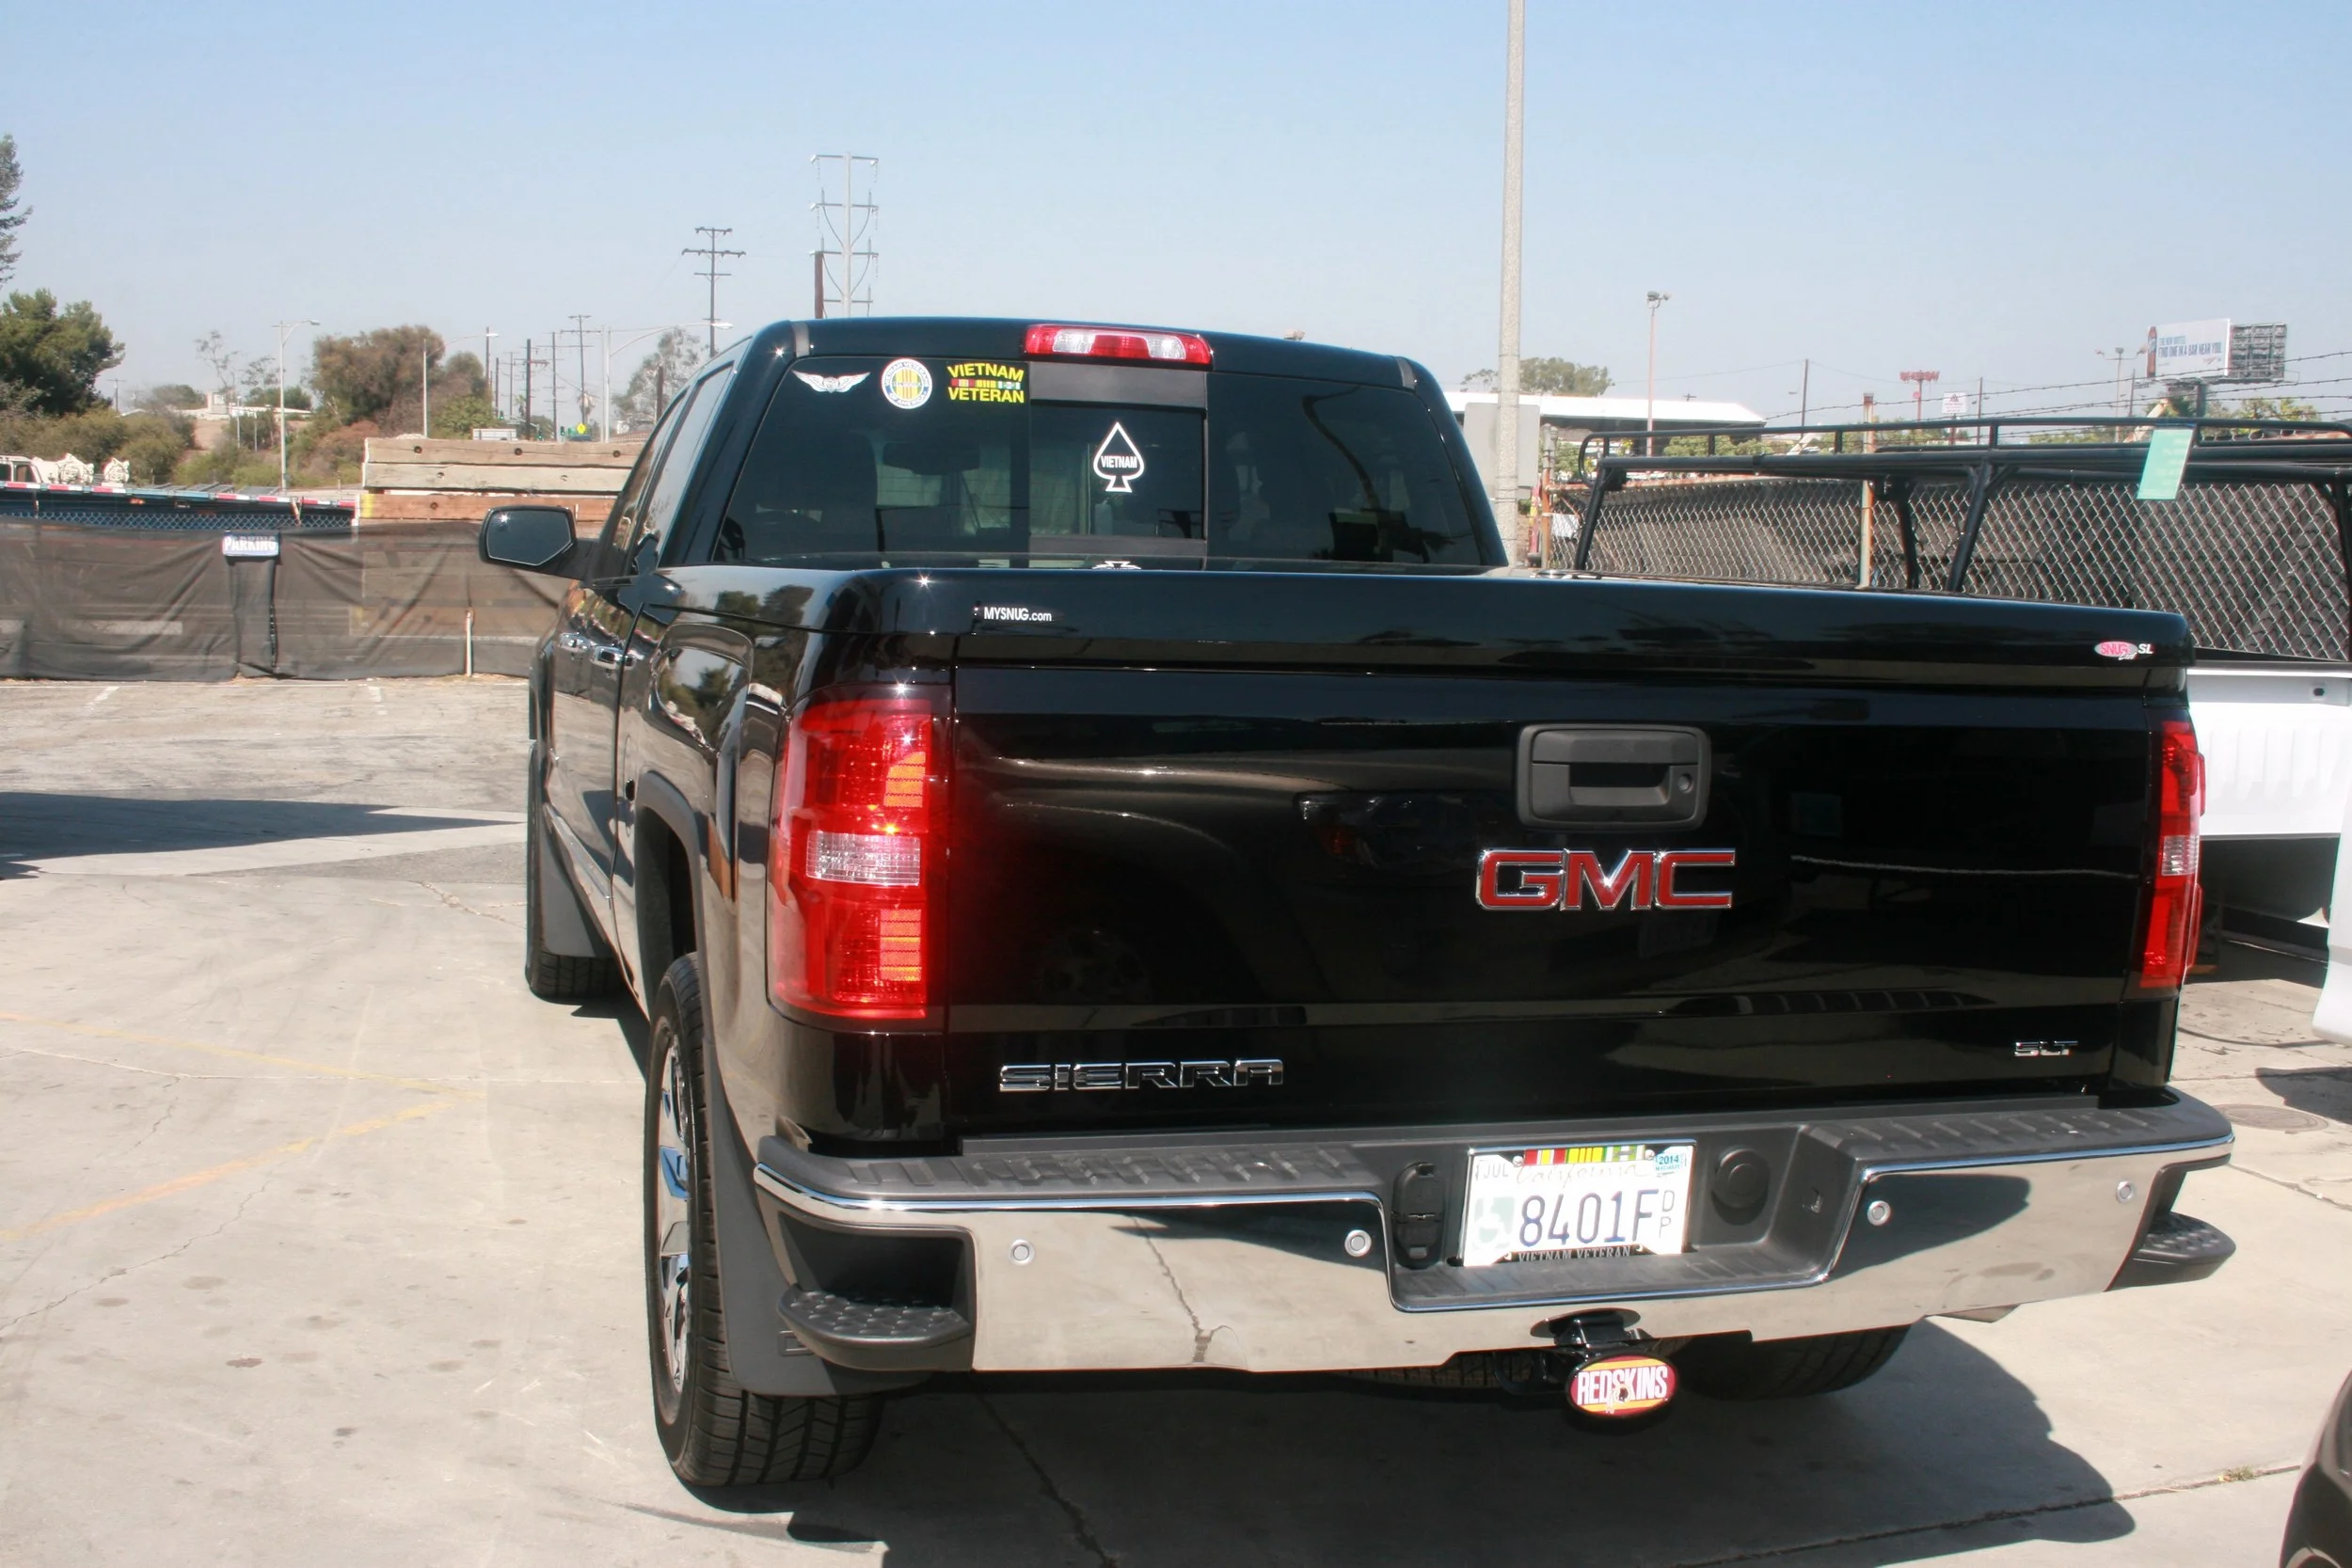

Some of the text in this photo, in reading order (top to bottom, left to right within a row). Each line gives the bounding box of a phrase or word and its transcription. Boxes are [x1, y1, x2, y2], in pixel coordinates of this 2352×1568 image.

[2158, 346, 2169, 358] FIND
[2169, 345, 2178, 357] ONE
[2188, 343, 2198, 356] BAR
[2199, 342, 2211, 355] NEAR
[946, 362, 1025, 382] VIETNAM
[947, 387, 1025, 404] VETERAN
[1101, 455, 1137, 468] VIETNAM
[224, 535, 277, 551] PARKING
[983, 607, 1053, 622] MYSNUG.com
[2100, 642, 2153, 656] SNUG SL
[1475, 847, 1736, 911] GMC
[2014, 1040, 2078, 1057] SLT
[999, 1058, 1283, 1093] SIERRA
[1484, 1154, 1679, 1180] JUL 2014
[1516, 1160, 1651, 1189] California
[1518, 1188, 1660, 1248] 8401F
[1518, 1244, 1630, 1261] VIETNAM VETERAN
[1577, 1366, 1668, 1406] REDSKINS
